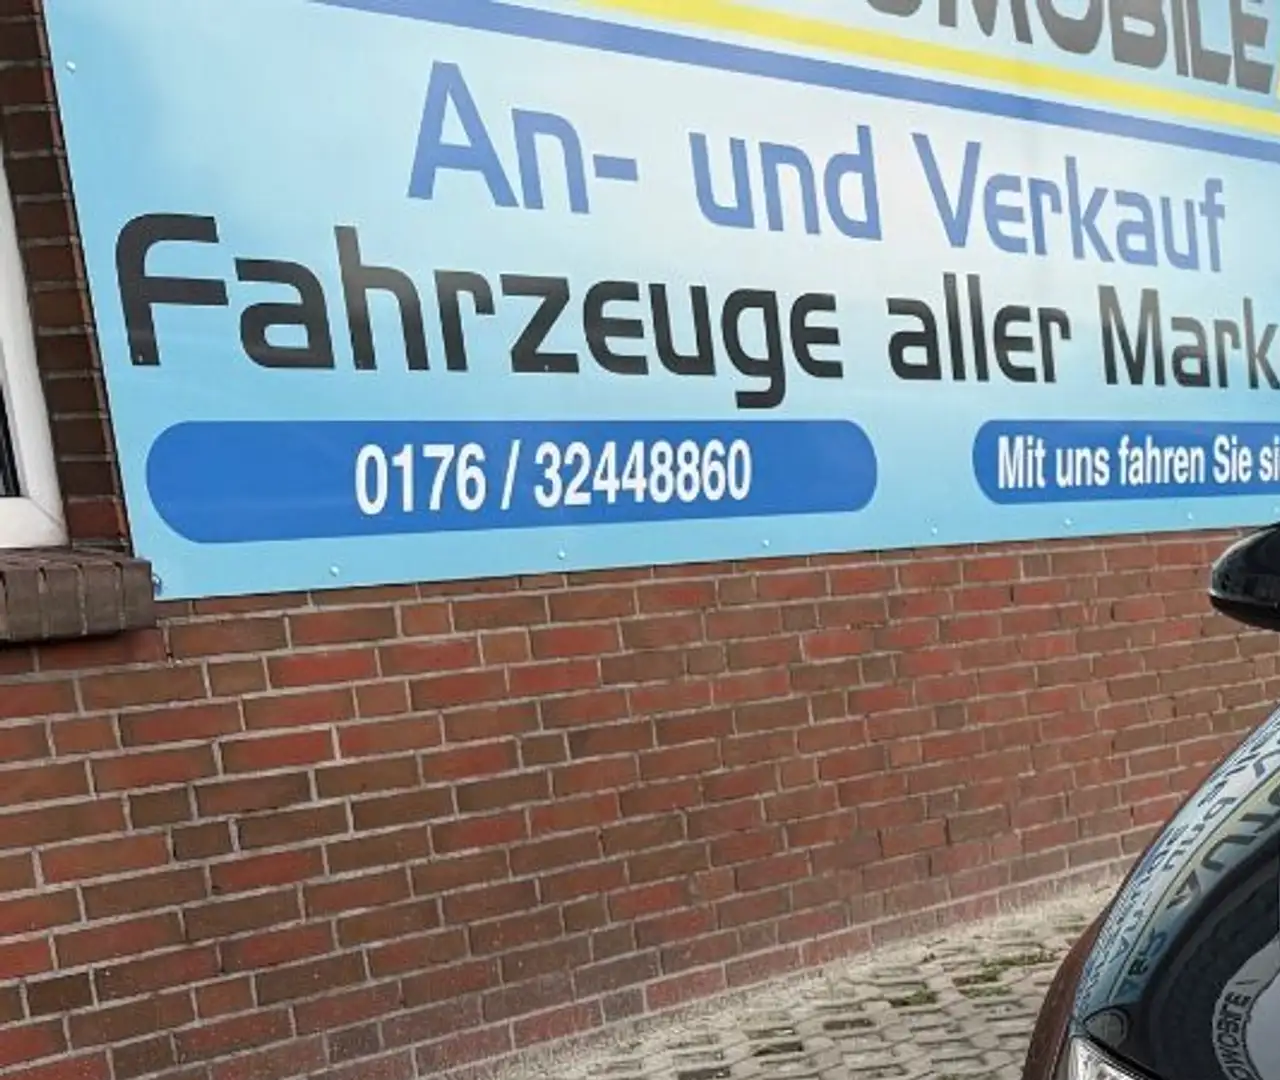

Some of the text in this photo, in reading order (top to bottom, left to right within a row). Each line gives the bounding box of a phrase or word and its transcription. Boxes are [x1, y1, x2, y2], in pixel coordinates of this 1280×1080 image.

[408, 60, 1225, 273] An- und Verkauf
[115, 213, 844, 410] Fahrzeuge
[886, 272, 1072, 383] aller
[355, 439, 753, 517] 0176 / 32448860
[997, 435, 1047, 489] Mit
[1055, 446, 1110, 488] uns
[1118, 434, 1206, 486] fahren
[1212, 434, 1252, 484] Sie
